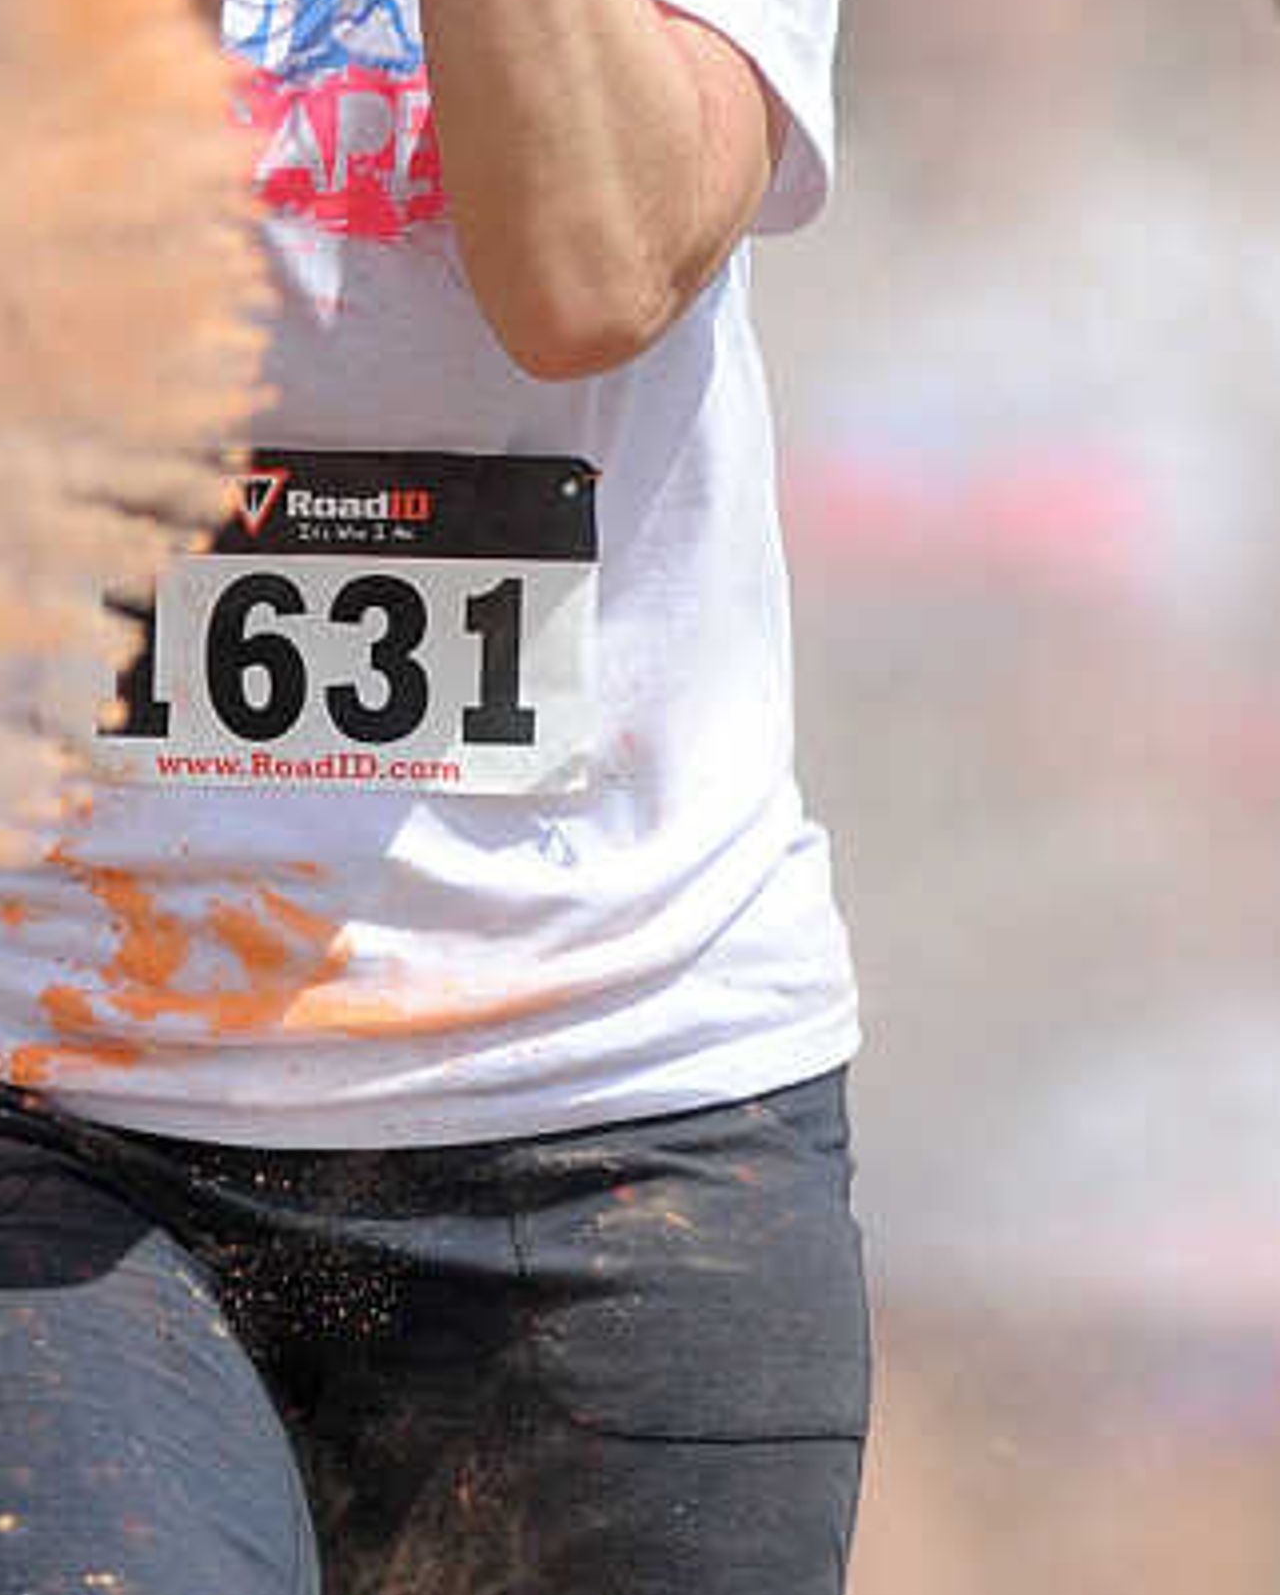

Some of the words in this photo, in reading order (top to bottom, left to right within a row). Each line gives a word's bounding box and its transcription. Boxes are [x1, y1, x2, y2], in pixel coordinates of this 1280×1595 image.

[286, 488, 431, 521] RoadID
[97, 571, 536, 746] 1631
[156, 752, 462, 783] www.RoadID.com
